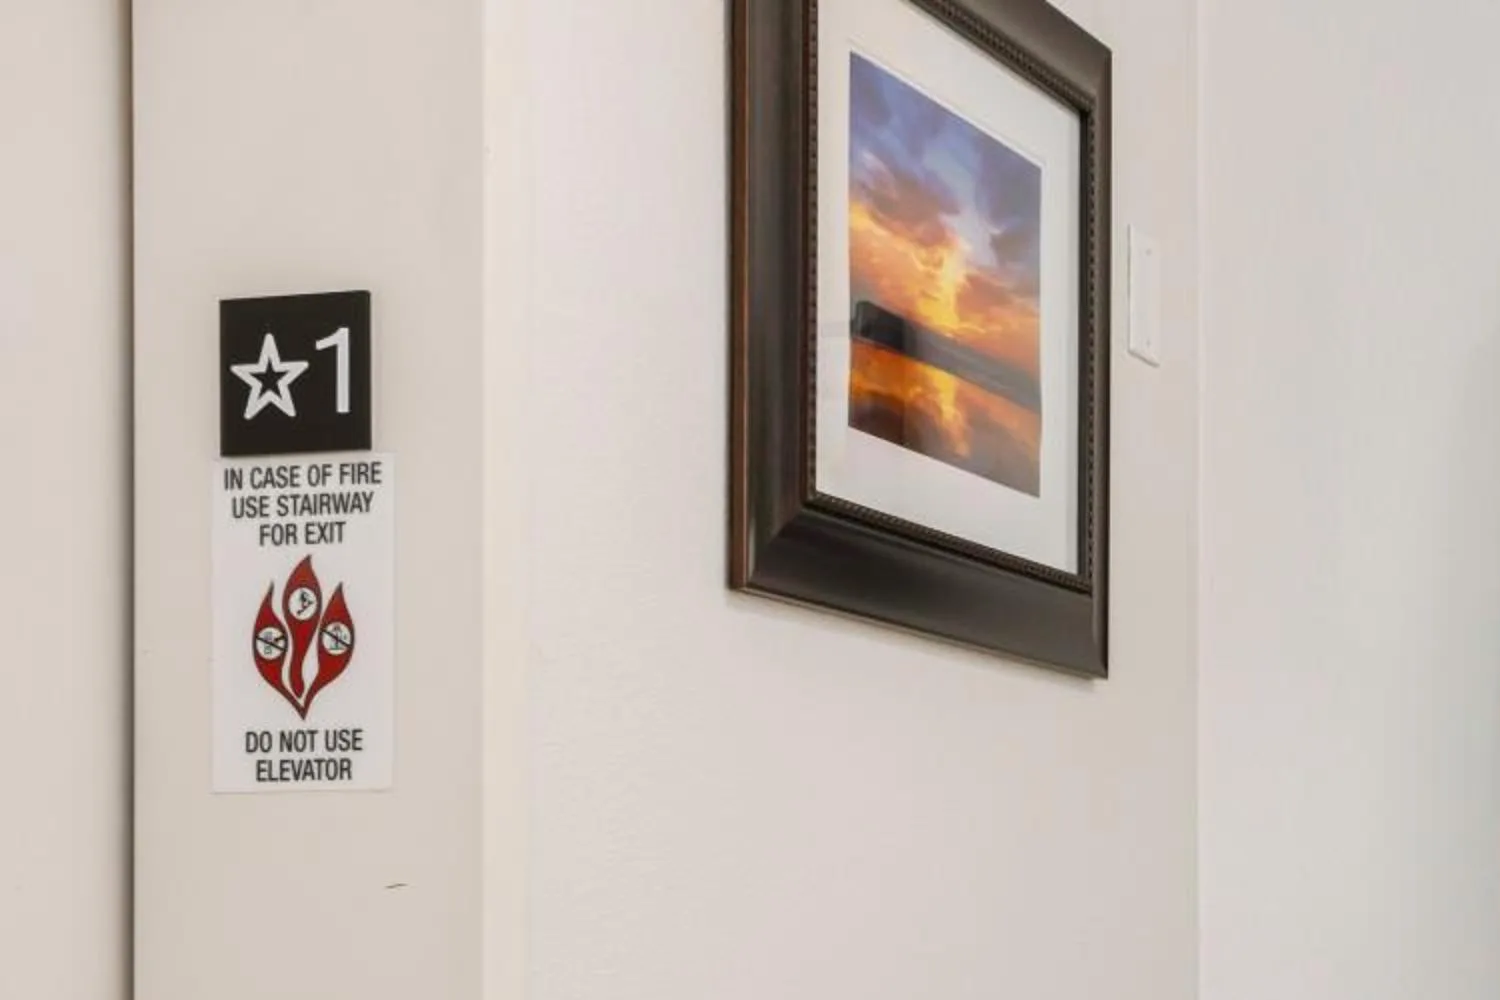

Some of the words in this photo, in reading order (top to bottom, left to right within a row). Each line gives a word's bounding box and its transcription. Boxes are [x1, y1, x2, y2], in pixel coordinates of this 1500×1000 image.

[316, 327, 350, 414] 1
[224, 468, 246, 489] IN
[250, 466, 301, 488] CASE
[308, 464, 333, 485] OF
[339, 462, 382, 485] FIRE
[232, 497, 270, 518] USE
[277, 492, 374, 516] STAIRWAY
[259, 523, 298, 545] FOR
[305, 522, 345, 544] EXIT
[245, 731, 274, 753] DO
[280, 730, 318, 752] NOT
[325, 729, 363, 751] USE
[255, 758, 353, 781] ELEVATOR
